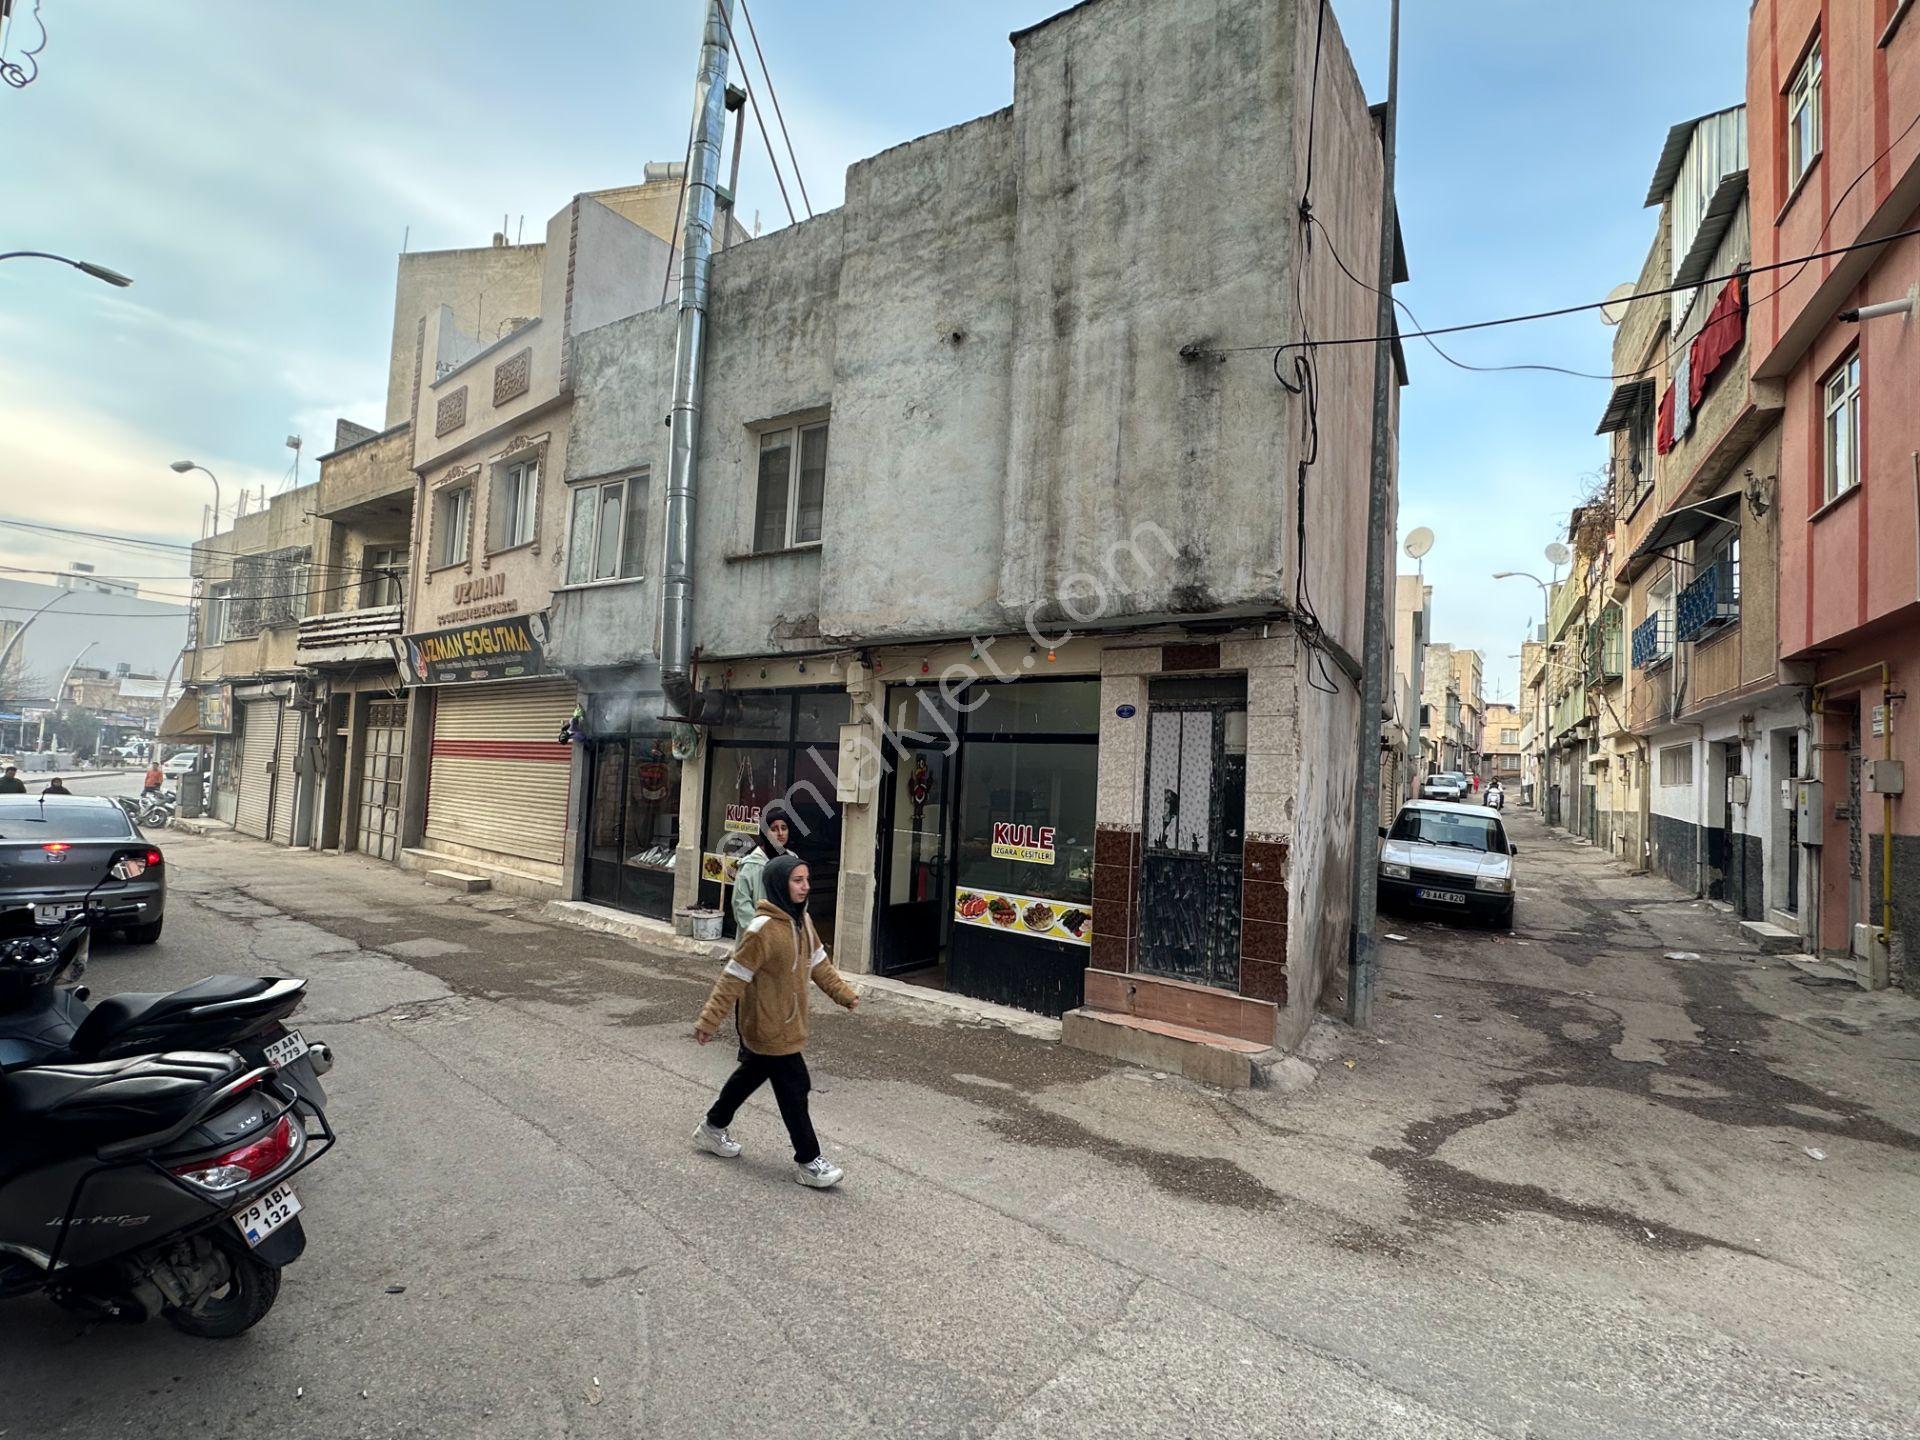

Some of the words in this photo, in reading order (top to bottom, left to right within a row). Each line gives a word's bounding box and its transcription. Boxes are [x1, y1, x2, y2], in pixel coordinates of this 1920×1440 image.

[453, 573, 506, 605] UZMAN
[419, 633, 464, 663] UZMAN
[462, 625, 533, 656] SOĞUTMA
[725, 804, 761, 824] KULE
[993, 822, 1056, 851] KULE
[266, 1045, 280, 1058] 79
[282, 1033, 300, 1049] AAY
[280, 1046, 301, 1063] 779
[240, 1206, 261, 1227] 79
[264, 1186, 292, 1211] ABL
[264, 1204, 291, 1228] 132
